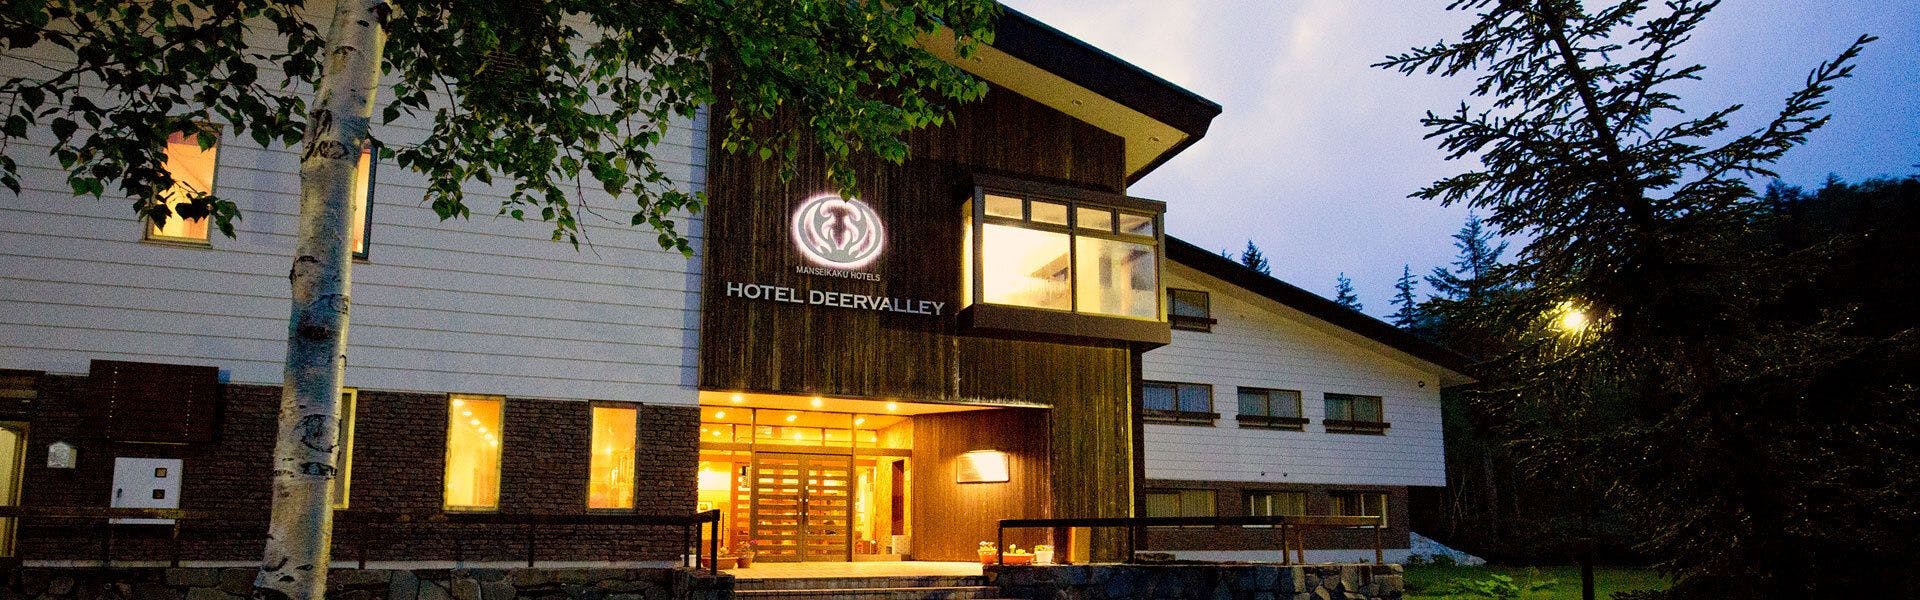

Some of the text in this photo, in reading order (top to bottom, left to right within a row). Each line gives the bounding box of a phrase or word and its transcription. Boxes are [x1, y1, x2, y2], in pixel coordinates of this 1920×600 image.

[796, 265, 881, 282] MANSEIKAKU HOTELS
[726, 282, 945, 316] HOTEL DEERVALLEY
